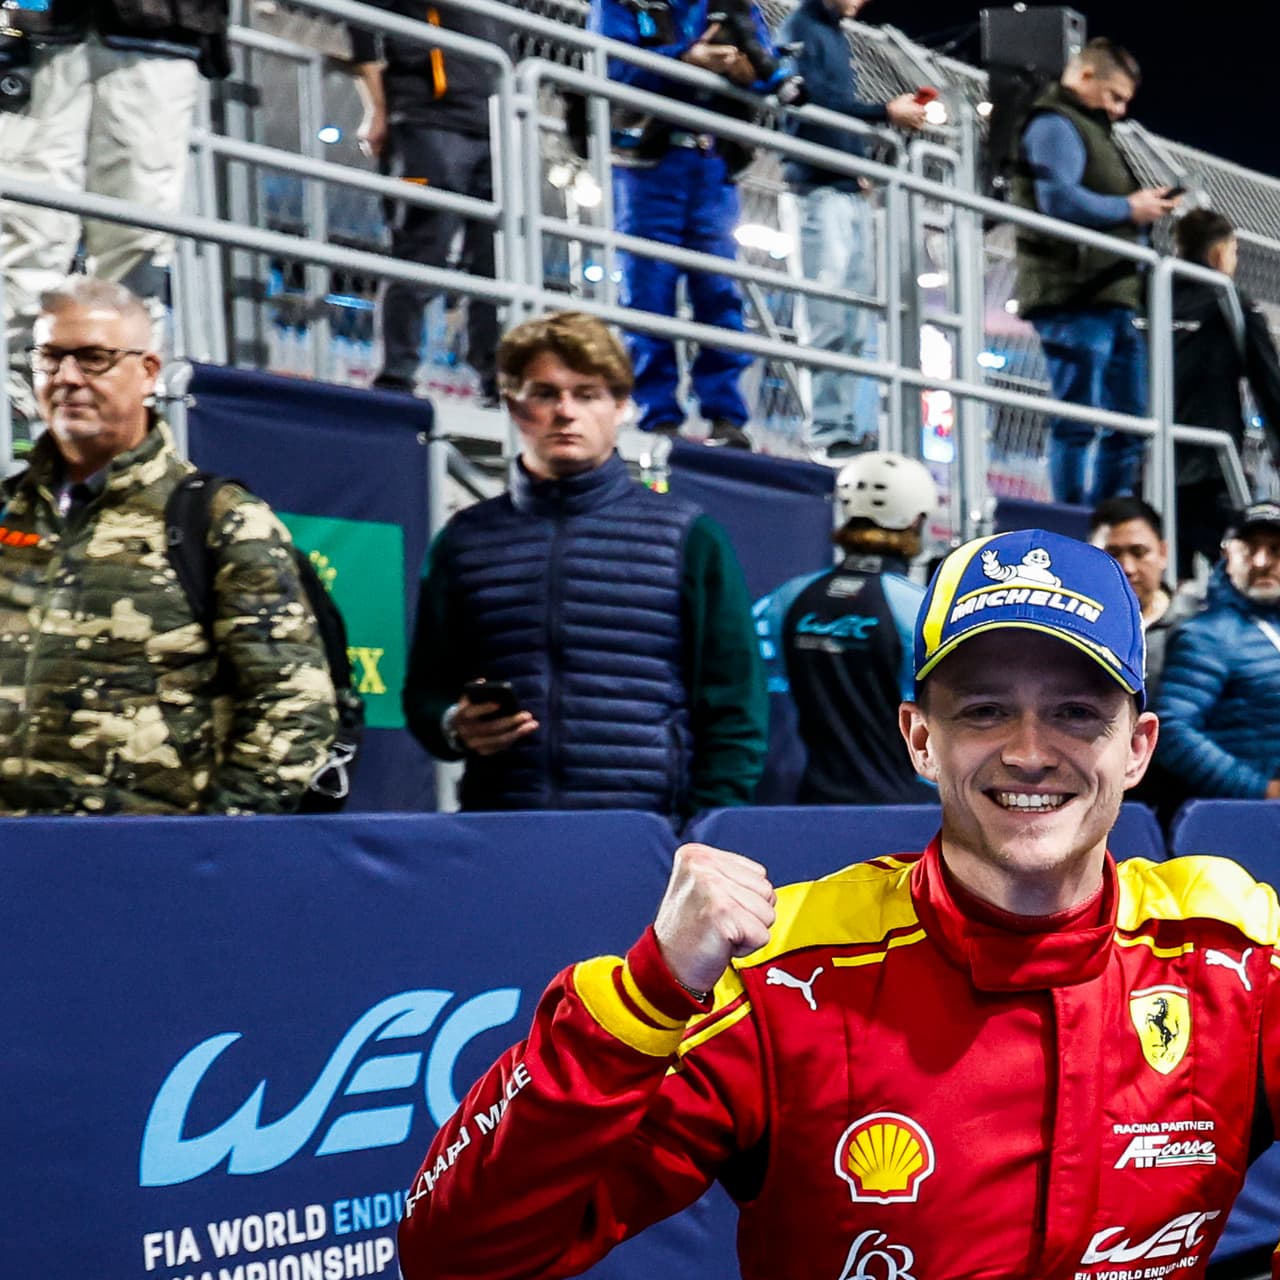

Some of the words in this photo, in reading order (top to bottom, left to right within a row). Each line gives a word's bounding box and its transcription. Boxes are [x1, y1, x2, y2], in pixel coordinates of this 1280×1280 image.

[950, 588, 1101, 624] MICHELIN
[138, 987, 522, 1188] WEC
[1113, 1123, 1160, 1134] RACING
[1161, 1121, 1214, 1132] PARTNER
[1113, 1135, 1170, 1169] AF
[143, 1226, 201, 1271] FIA
[207, 1204, 326, 1258] WORLD
[1080, 1210, 1221, 1264] WEC
